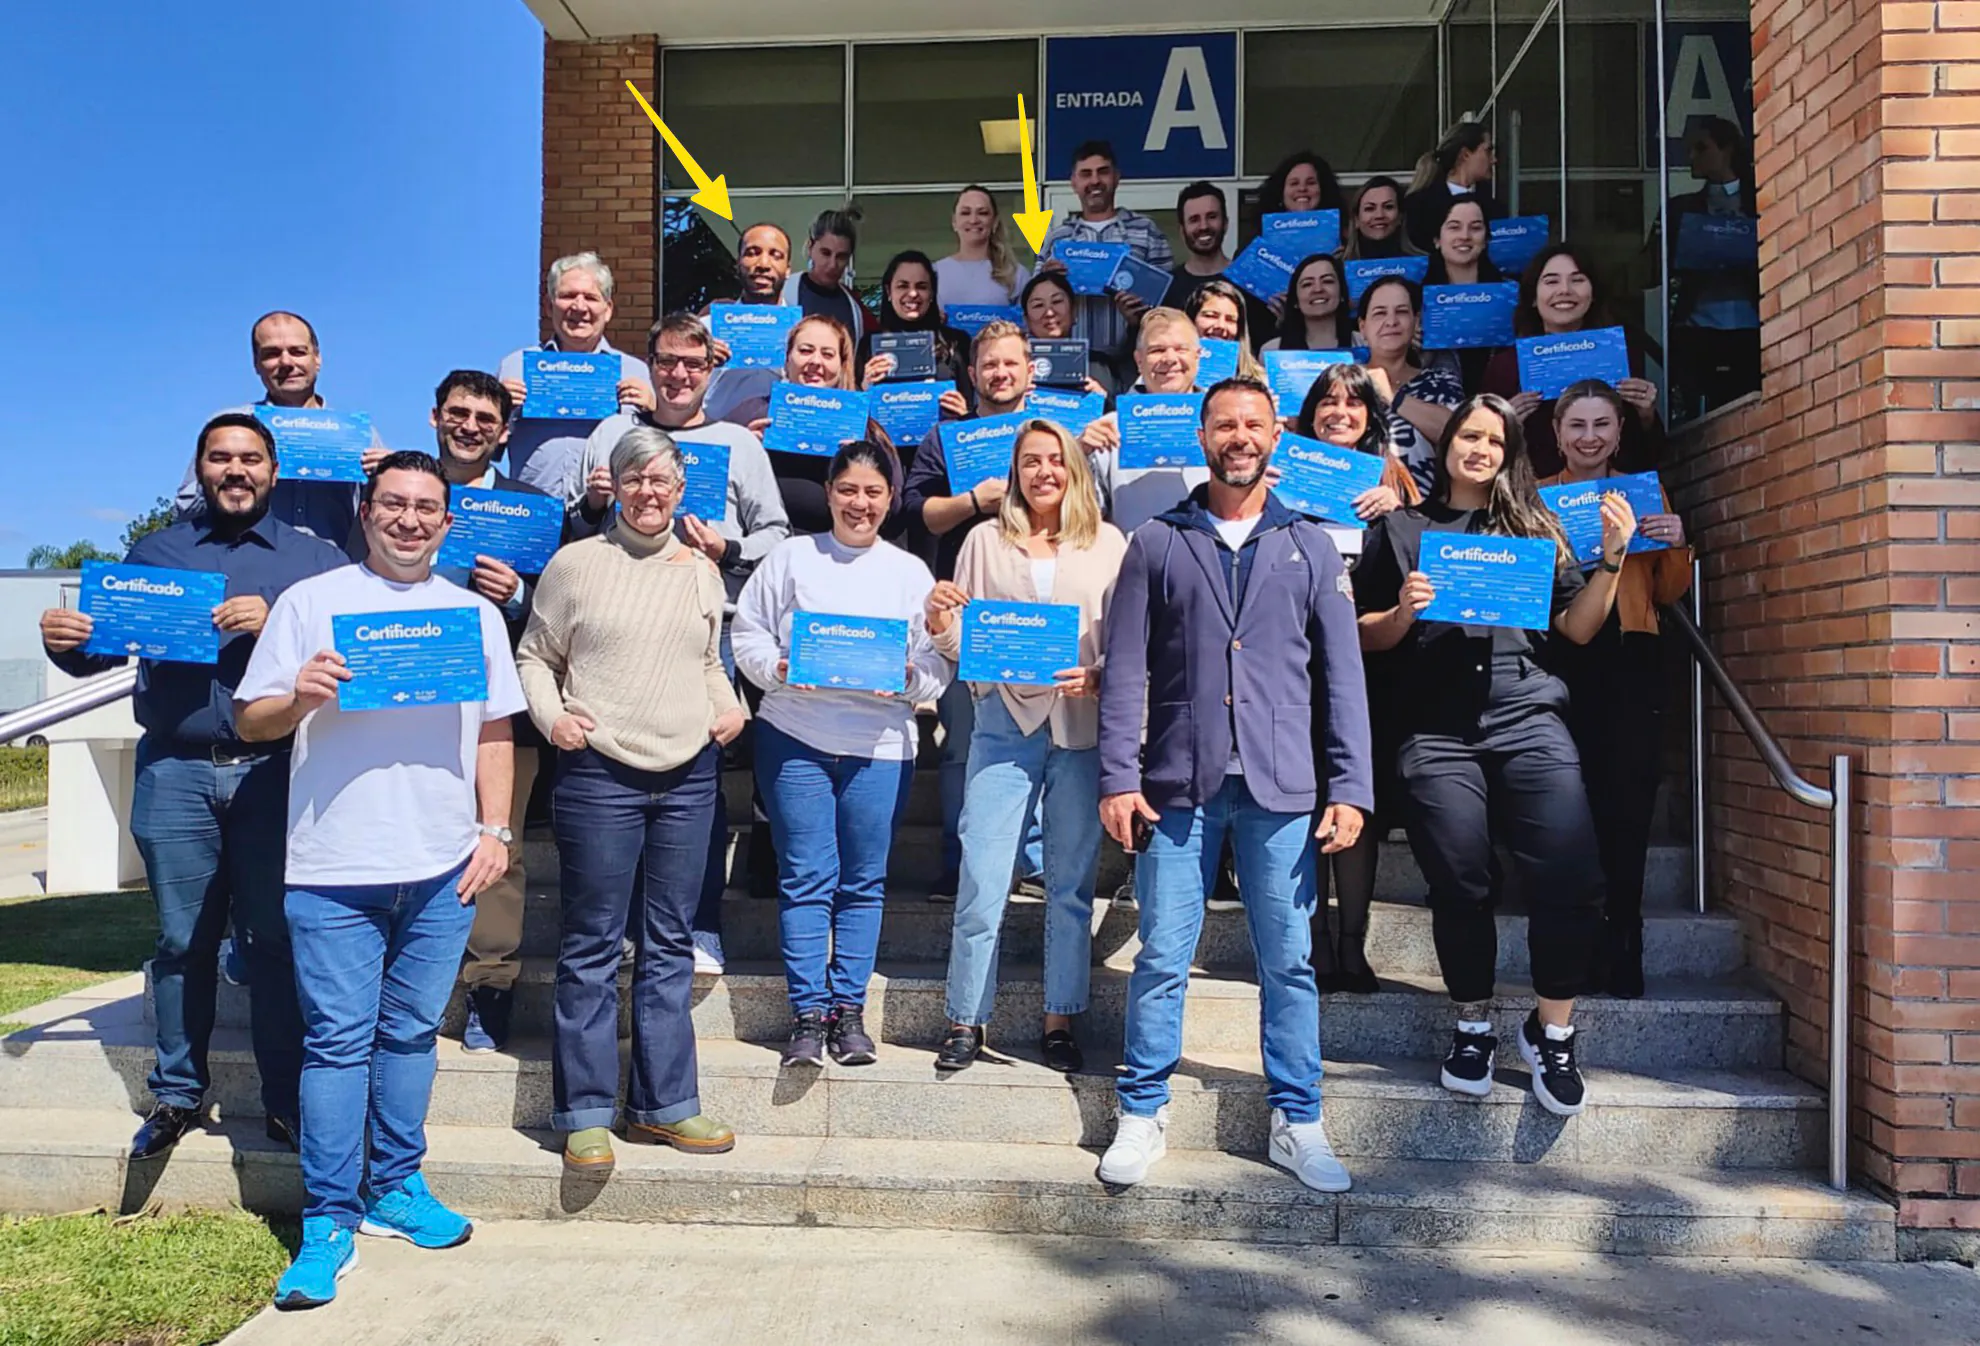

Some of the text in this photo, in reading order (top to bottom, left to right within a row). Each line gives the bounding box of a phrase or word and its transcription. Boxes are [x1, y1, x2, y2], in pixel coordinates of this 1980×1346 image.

[1056, 46, 1228, 151] ENTRADA A
[1273, 218, 1319, 229] Certificado
[1065, 247, 1109, 259] Certificado
[1357, 264, 1406, 277] Certificado
[1436, 292, 1492, 304] Certificado
[724, 312, 778, 324] Certificado
[1533, 339, 1596, 356] Certificado
[537, 360, 595, 373] Certificado
[785, 392, 842, 410] Certificado
[881, 391, 933, 403] Certificado
[1029, 393, 1080, 410] Certificado
[1132, 402, 1194, 417] Certificado
[271, 415, 340, 431] Certificado
[956, 423, 1015, 443] Certificado
[1288, 445, 1352, 471] Certificado
[461, 497, 531, 518] Certificado
[1440, 545, 1517, 564] Certificado
[101, 574, 185, 597] Certificado
[979, 610, 1047, 628] Certificado
[355, 621, 443, 641] Certificado
[809, 622, 876, 639] Certificado
